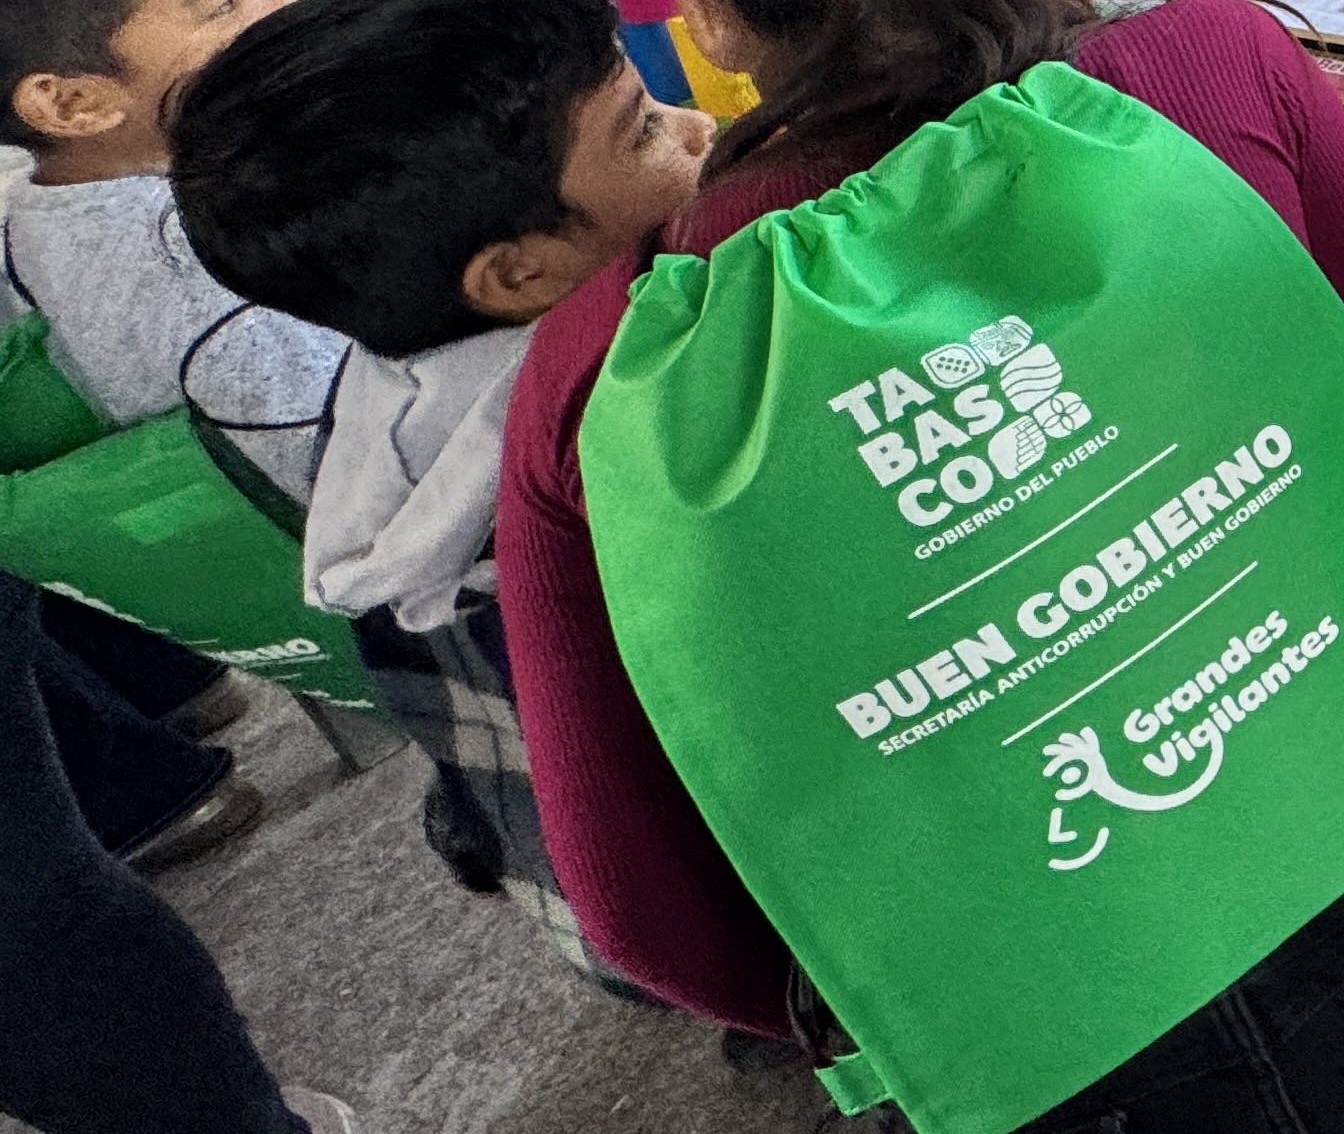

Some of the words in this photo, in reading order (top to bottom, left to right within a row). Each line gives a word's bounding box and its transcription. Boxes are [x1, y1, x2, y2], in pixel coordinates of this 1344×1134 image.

[914, 496, 1015, 560] GOBIERNO
[1014, 472, 1054, 502] DEL
[1051, 425, 1119, 477] PUEBLO
[835, 622, 1017, 740] BUEN
[1017, 424, 1293, 638] GOBIERNO
[877, 688, 996, 756] SECRETARÍA
[997, 574, 1163, 695] ANTICORRUPCIÓN
[1161, 562, 1176, 579] Y
[1176, 526, 1225, 569] BUEN
[1224, 463, 1302, 531] GOBIERNO
[1124, 610, 1288, 743] Grandes
[1142, 615, 1340, 778] Vigilantes
